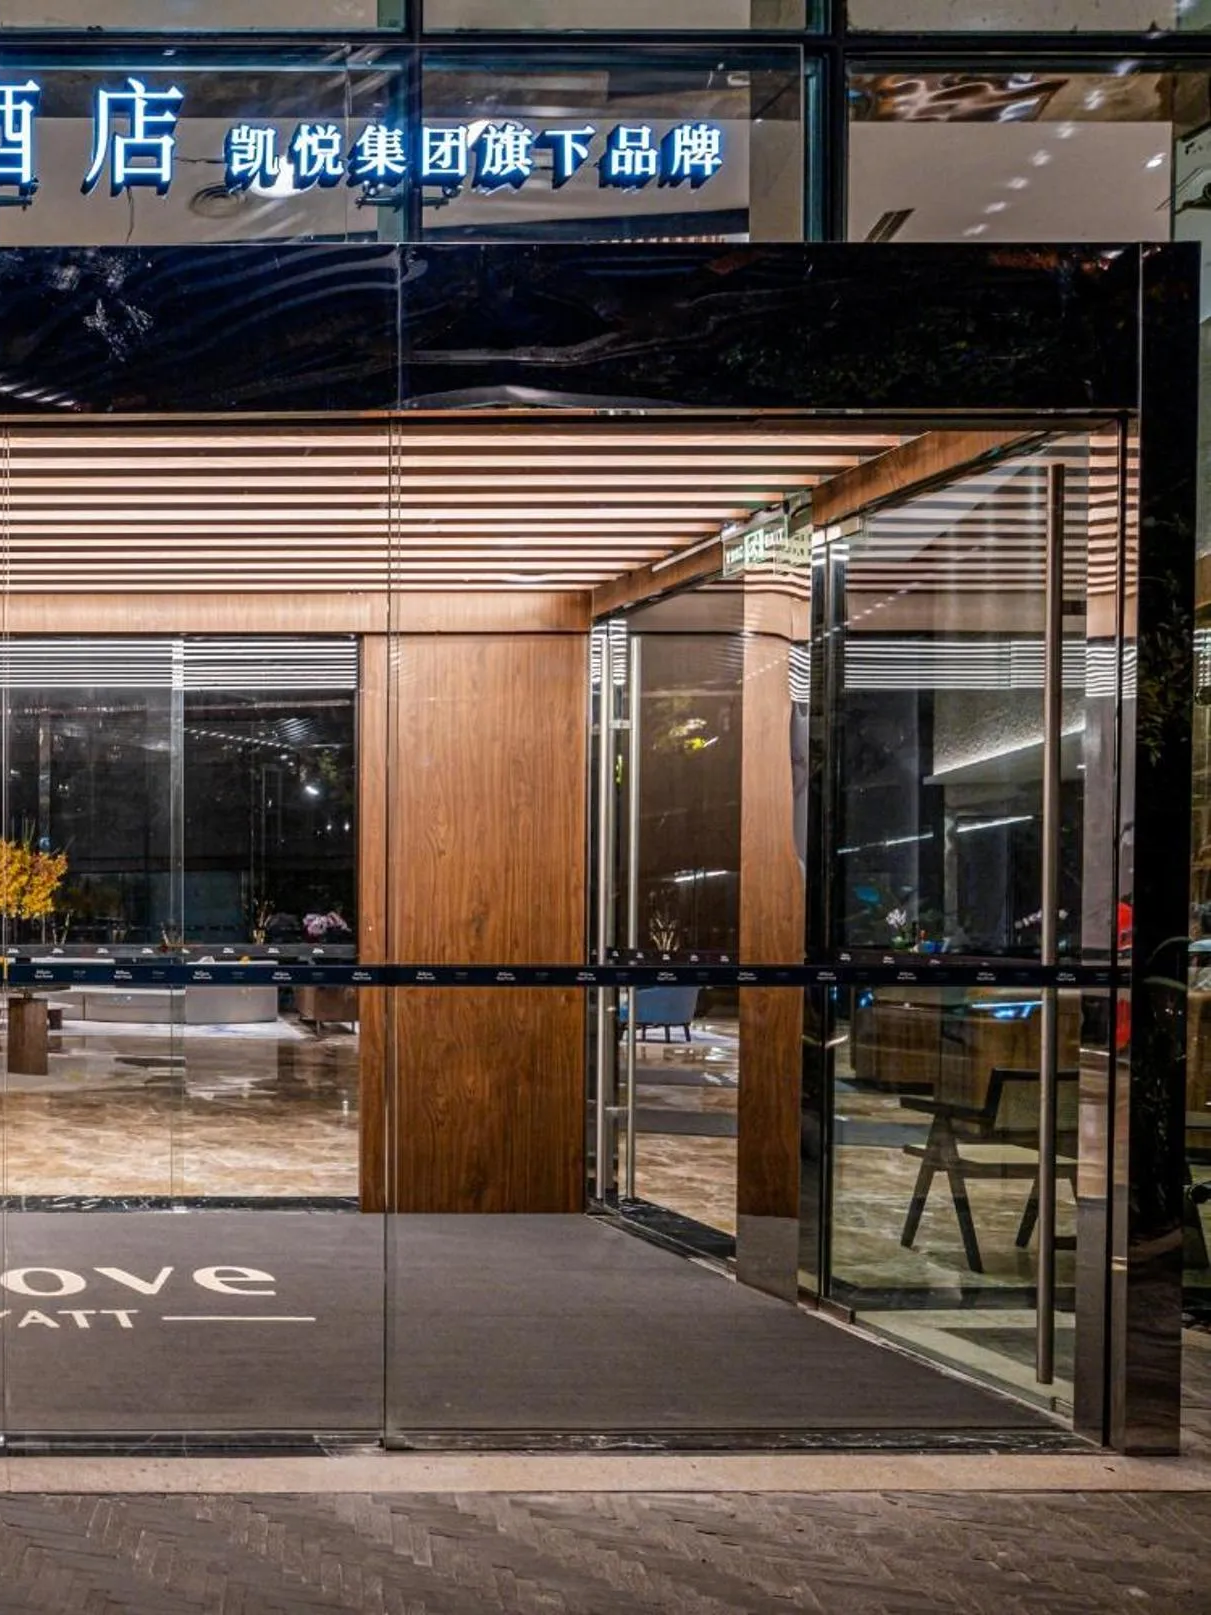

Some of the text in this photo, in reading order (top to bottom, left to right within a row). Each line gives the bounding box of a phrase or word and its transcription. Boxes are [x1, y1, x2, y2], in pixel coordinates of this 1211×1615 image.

[229, 123, 724, 181] 凯悦集团旗下品牌
